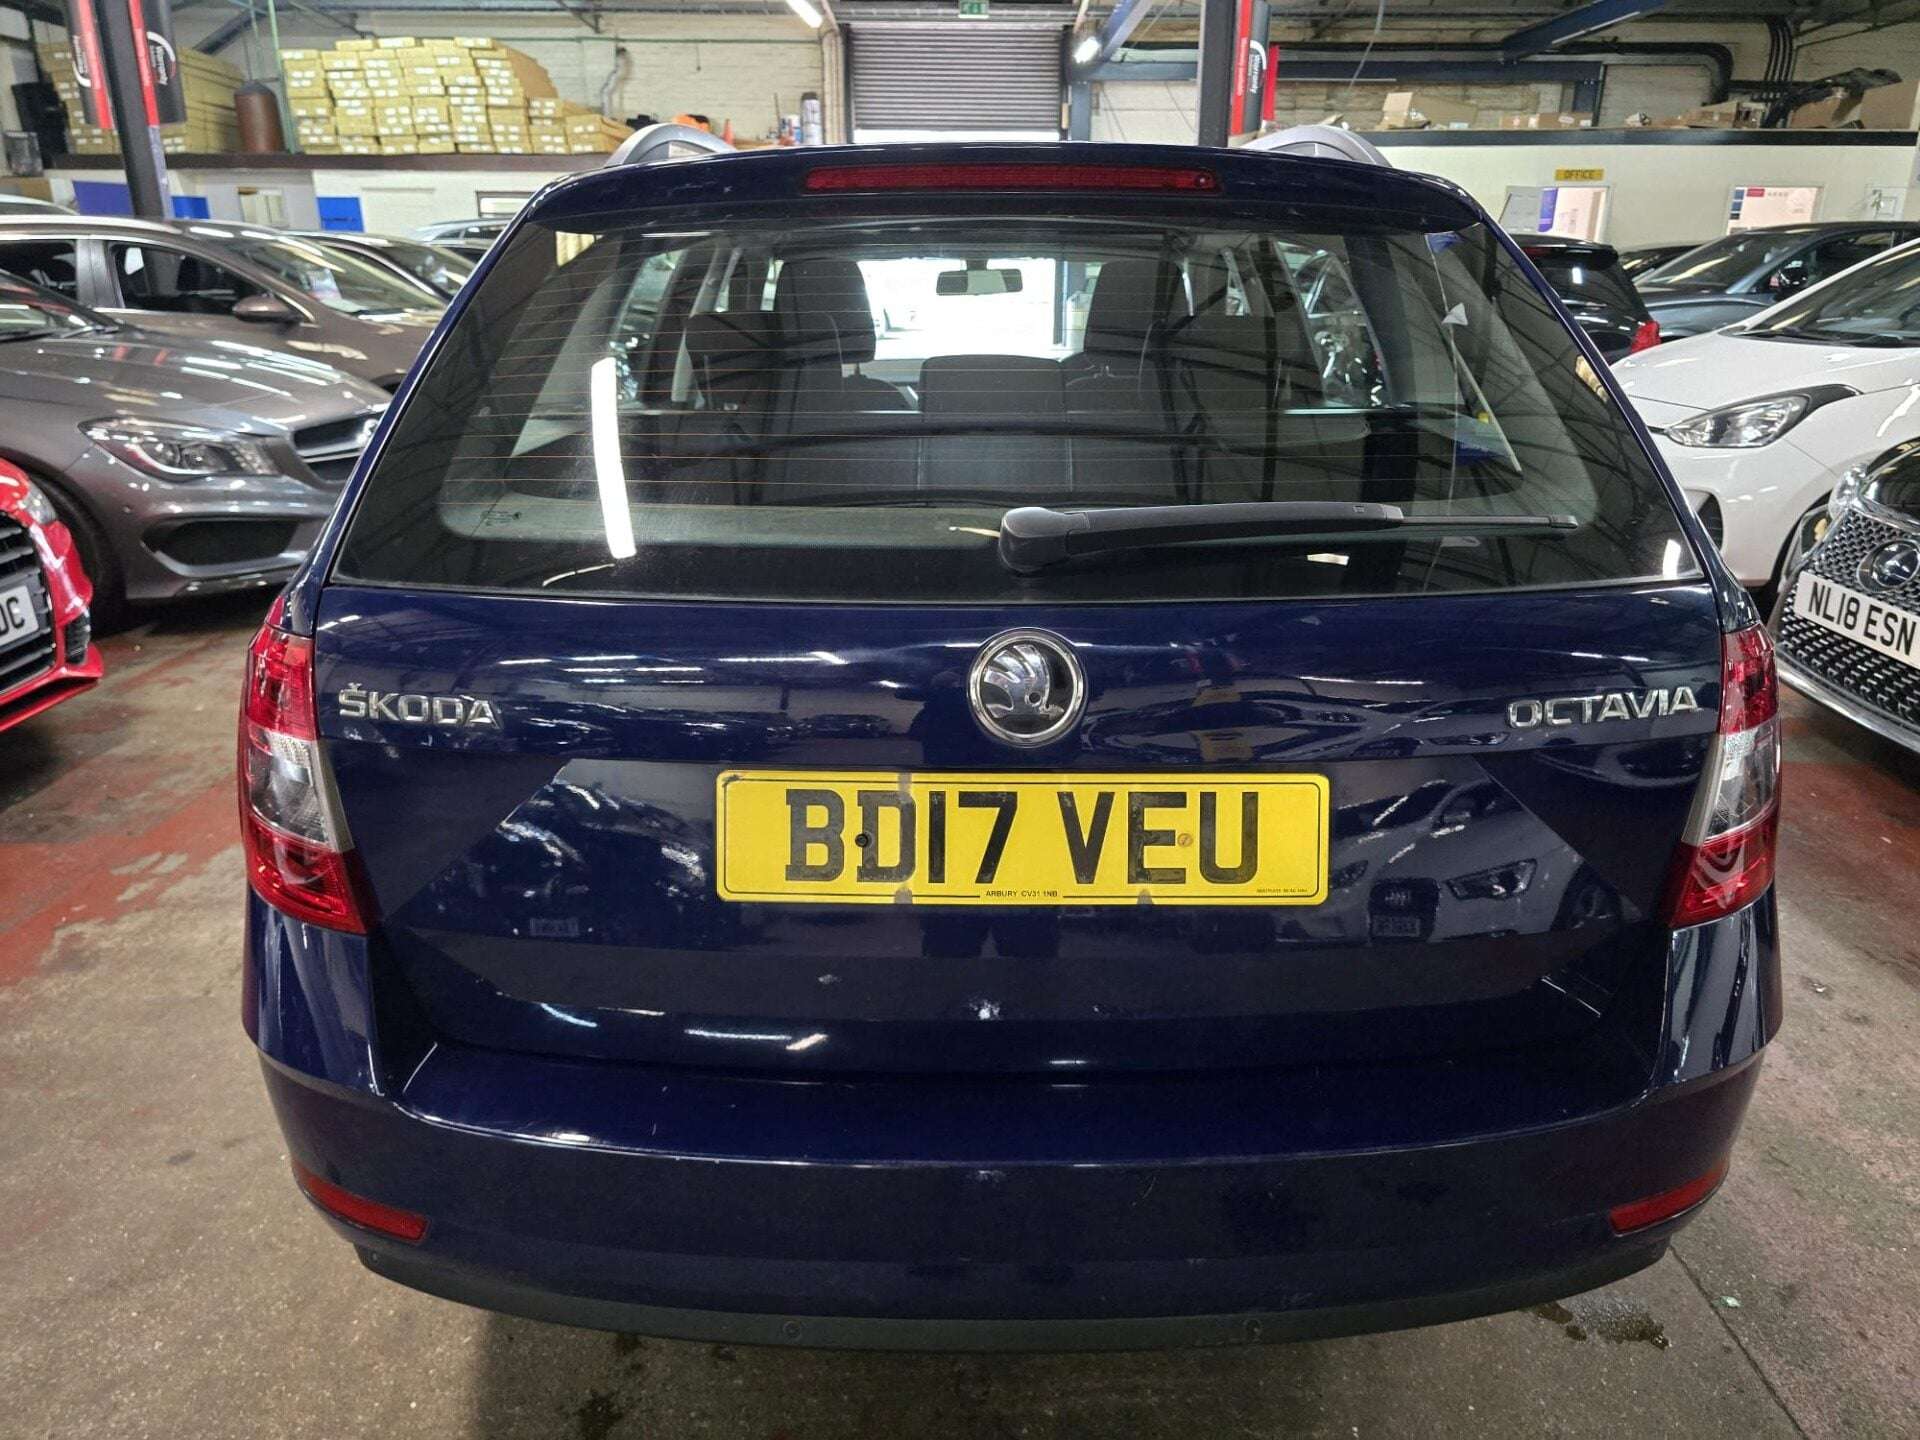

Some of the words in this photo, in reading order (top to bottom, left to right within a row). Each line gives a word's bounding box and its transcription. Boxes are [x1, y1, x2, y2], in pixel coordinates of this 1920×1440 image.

[1808, 581, 1860, 631] NL18
[1863, 604, 1917, 656] ESN
[338, 682, 500, 730] ŠKODA
[1508, 686, 1703, 729] OCTAVIA
[785, 788, 1018, 884] BD17
[1056, 790, 1259, 885] VEU
